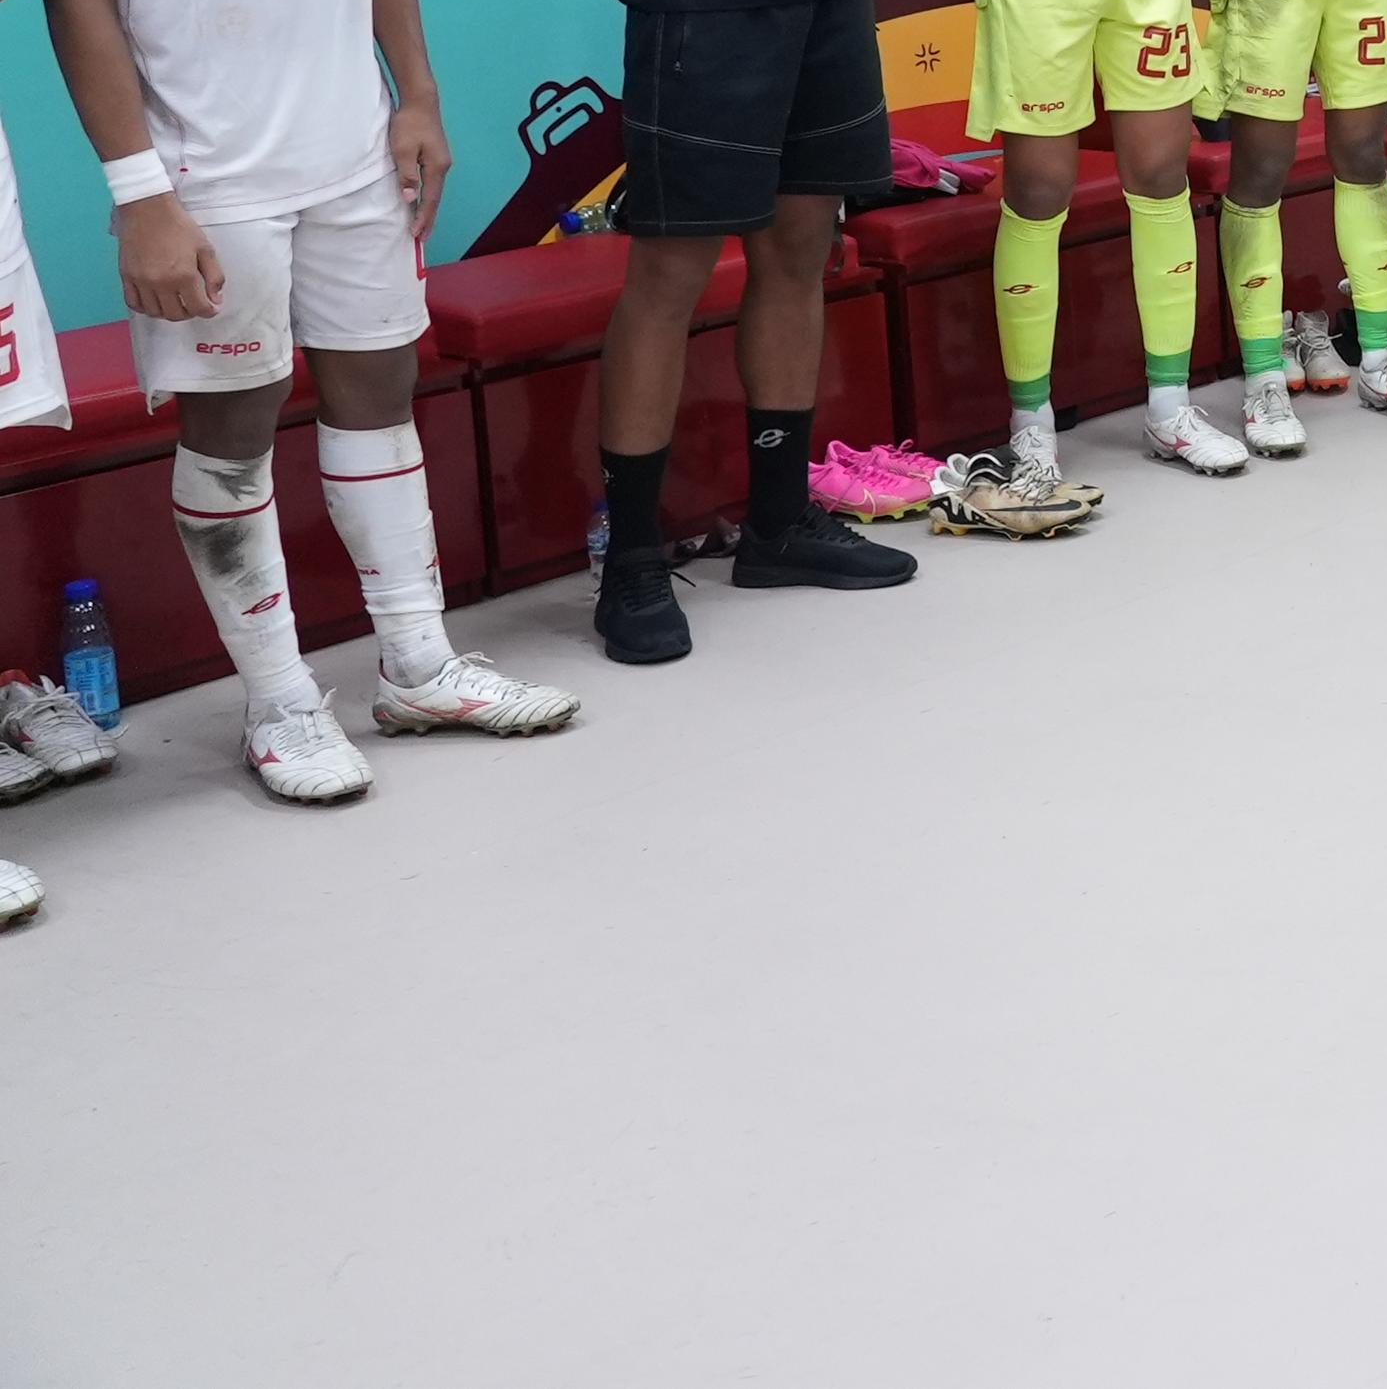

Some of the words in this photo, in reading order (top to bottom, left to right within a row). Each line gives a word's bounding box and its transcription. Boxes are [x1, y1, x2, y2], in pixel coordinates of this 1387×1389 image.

[1137, 23, 1192, 79] 23
[1246, 85, 1286, 98] erspo
[1022, 101, 1065, 114] erspo
[196, 341, 262, 357] erspo
